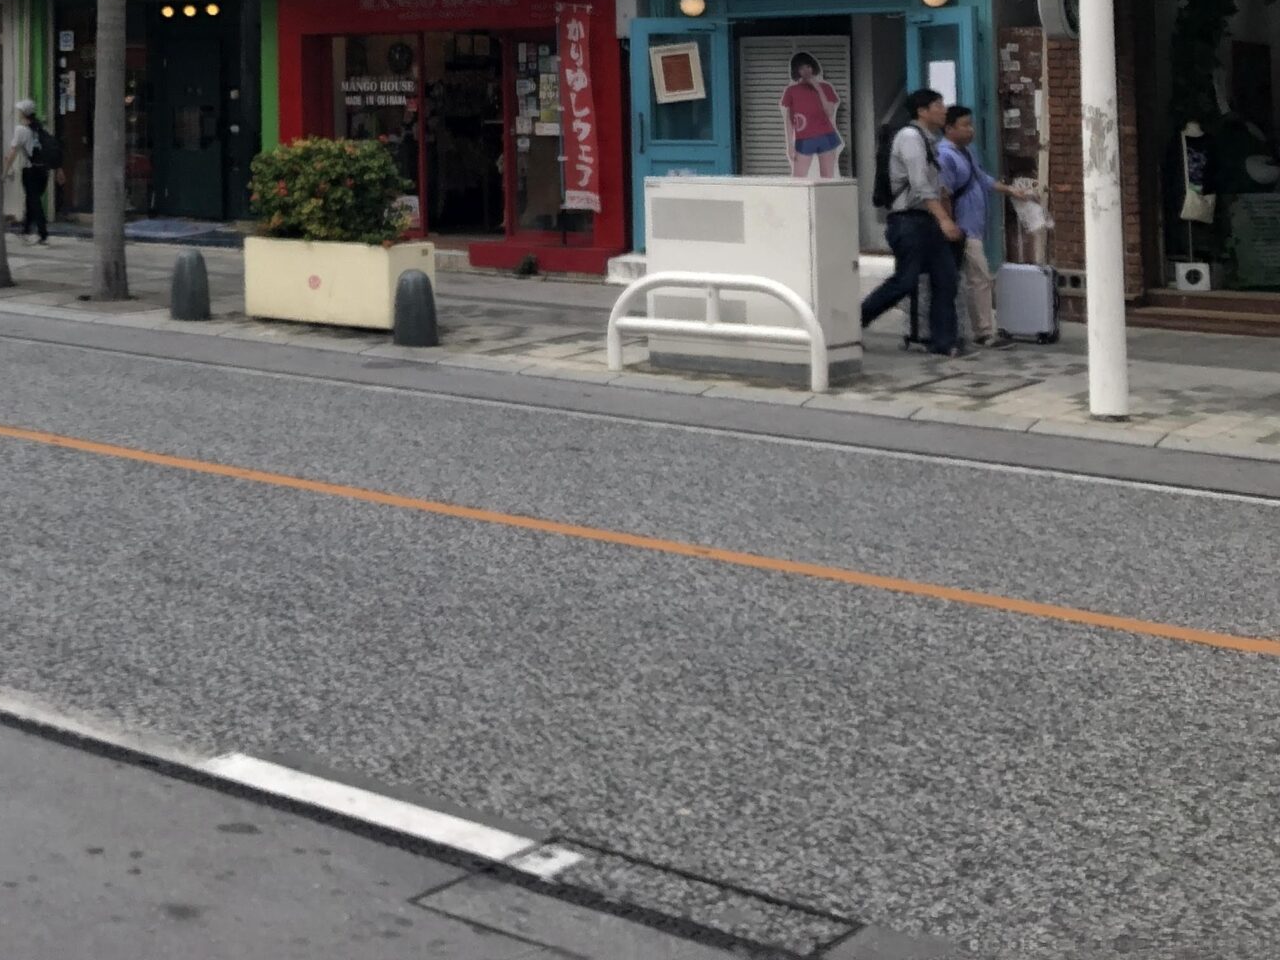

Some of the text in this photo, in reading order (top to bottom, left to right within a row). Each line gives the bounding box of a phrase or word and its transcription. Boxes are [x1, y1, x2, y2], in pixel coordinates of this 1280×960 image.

[341, 80, 415, 92] MANGO HOUSE
[345, 96, 362, 106] MADE
[566, 18, 594, 188] かりゆしウェア
